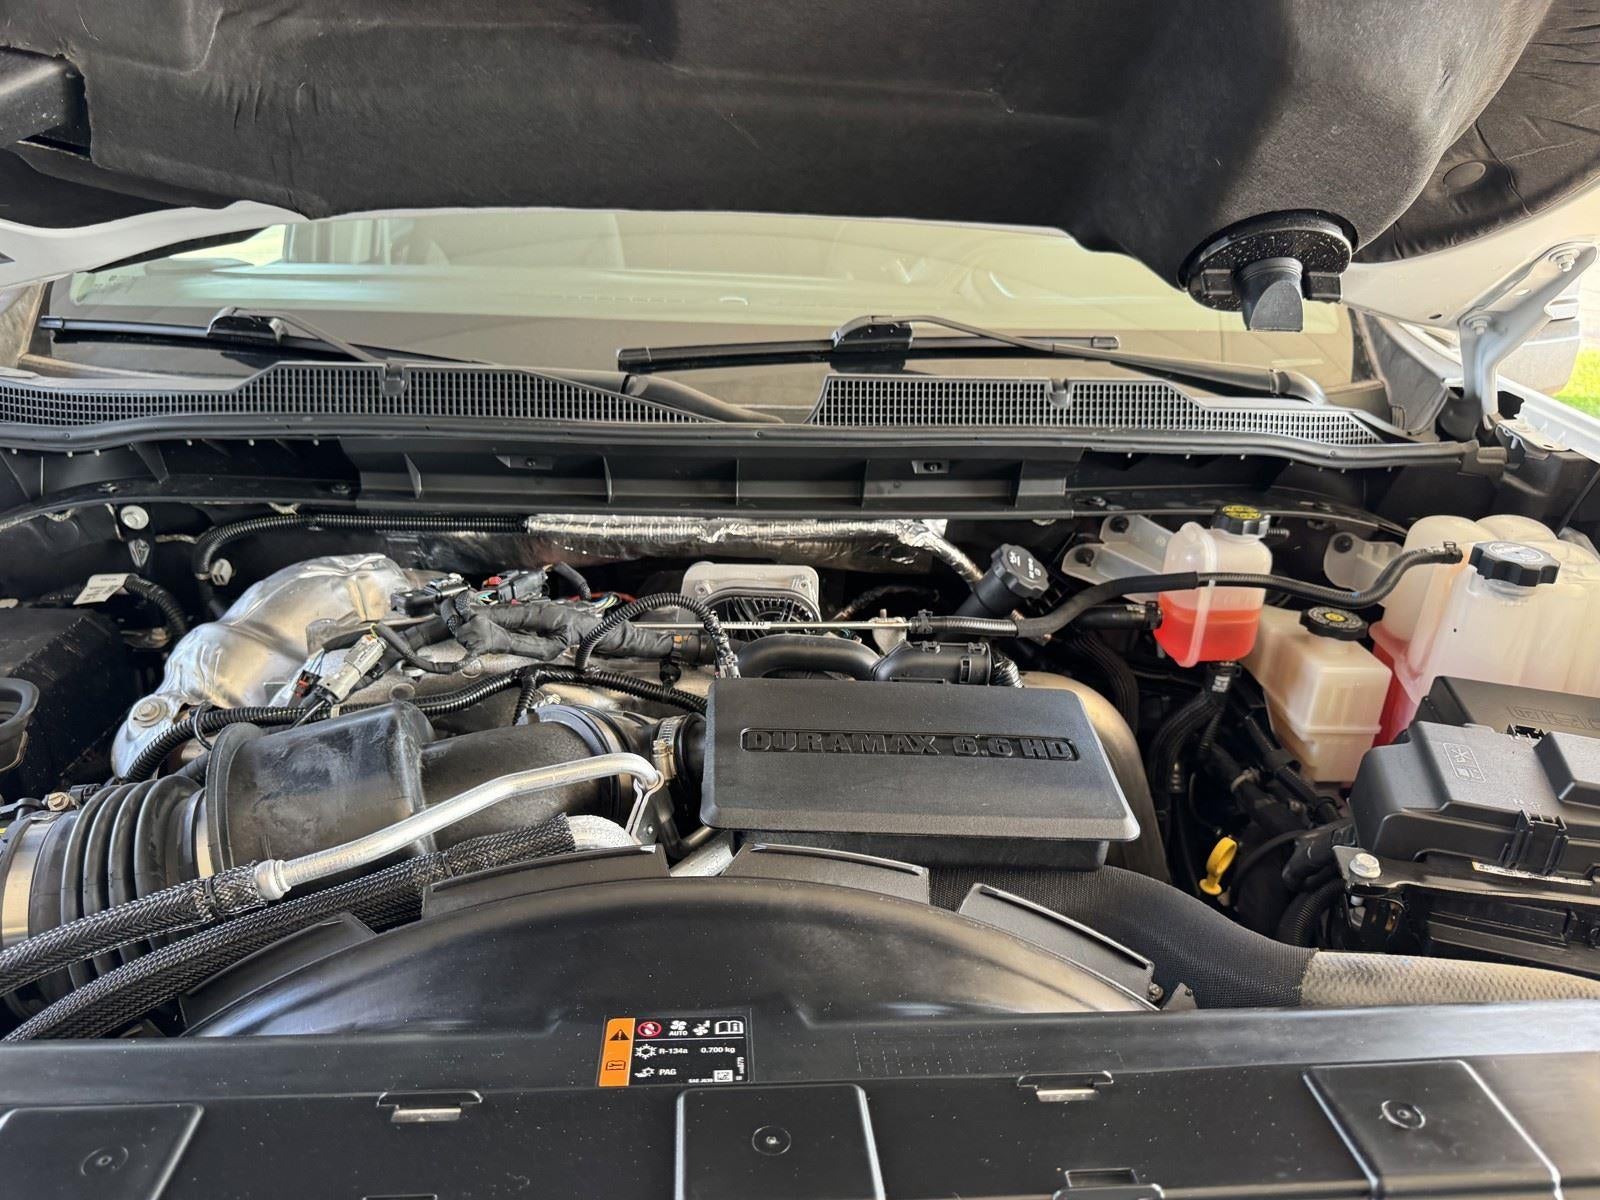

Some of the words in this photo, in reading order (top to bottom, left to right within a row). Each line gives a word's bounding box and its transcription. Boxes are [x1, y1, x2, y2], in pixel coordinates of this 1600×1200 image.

[746, 731, 940, 754] DURAMAX
[952, 735, 1013, 757] 6.6
[1019, 738, 1073, 759] HD
[700, 1046, 723, 1054] 0.700
[724, 1046, 736, 1054] kg
[659, 1068, 677, 1076] PAG
